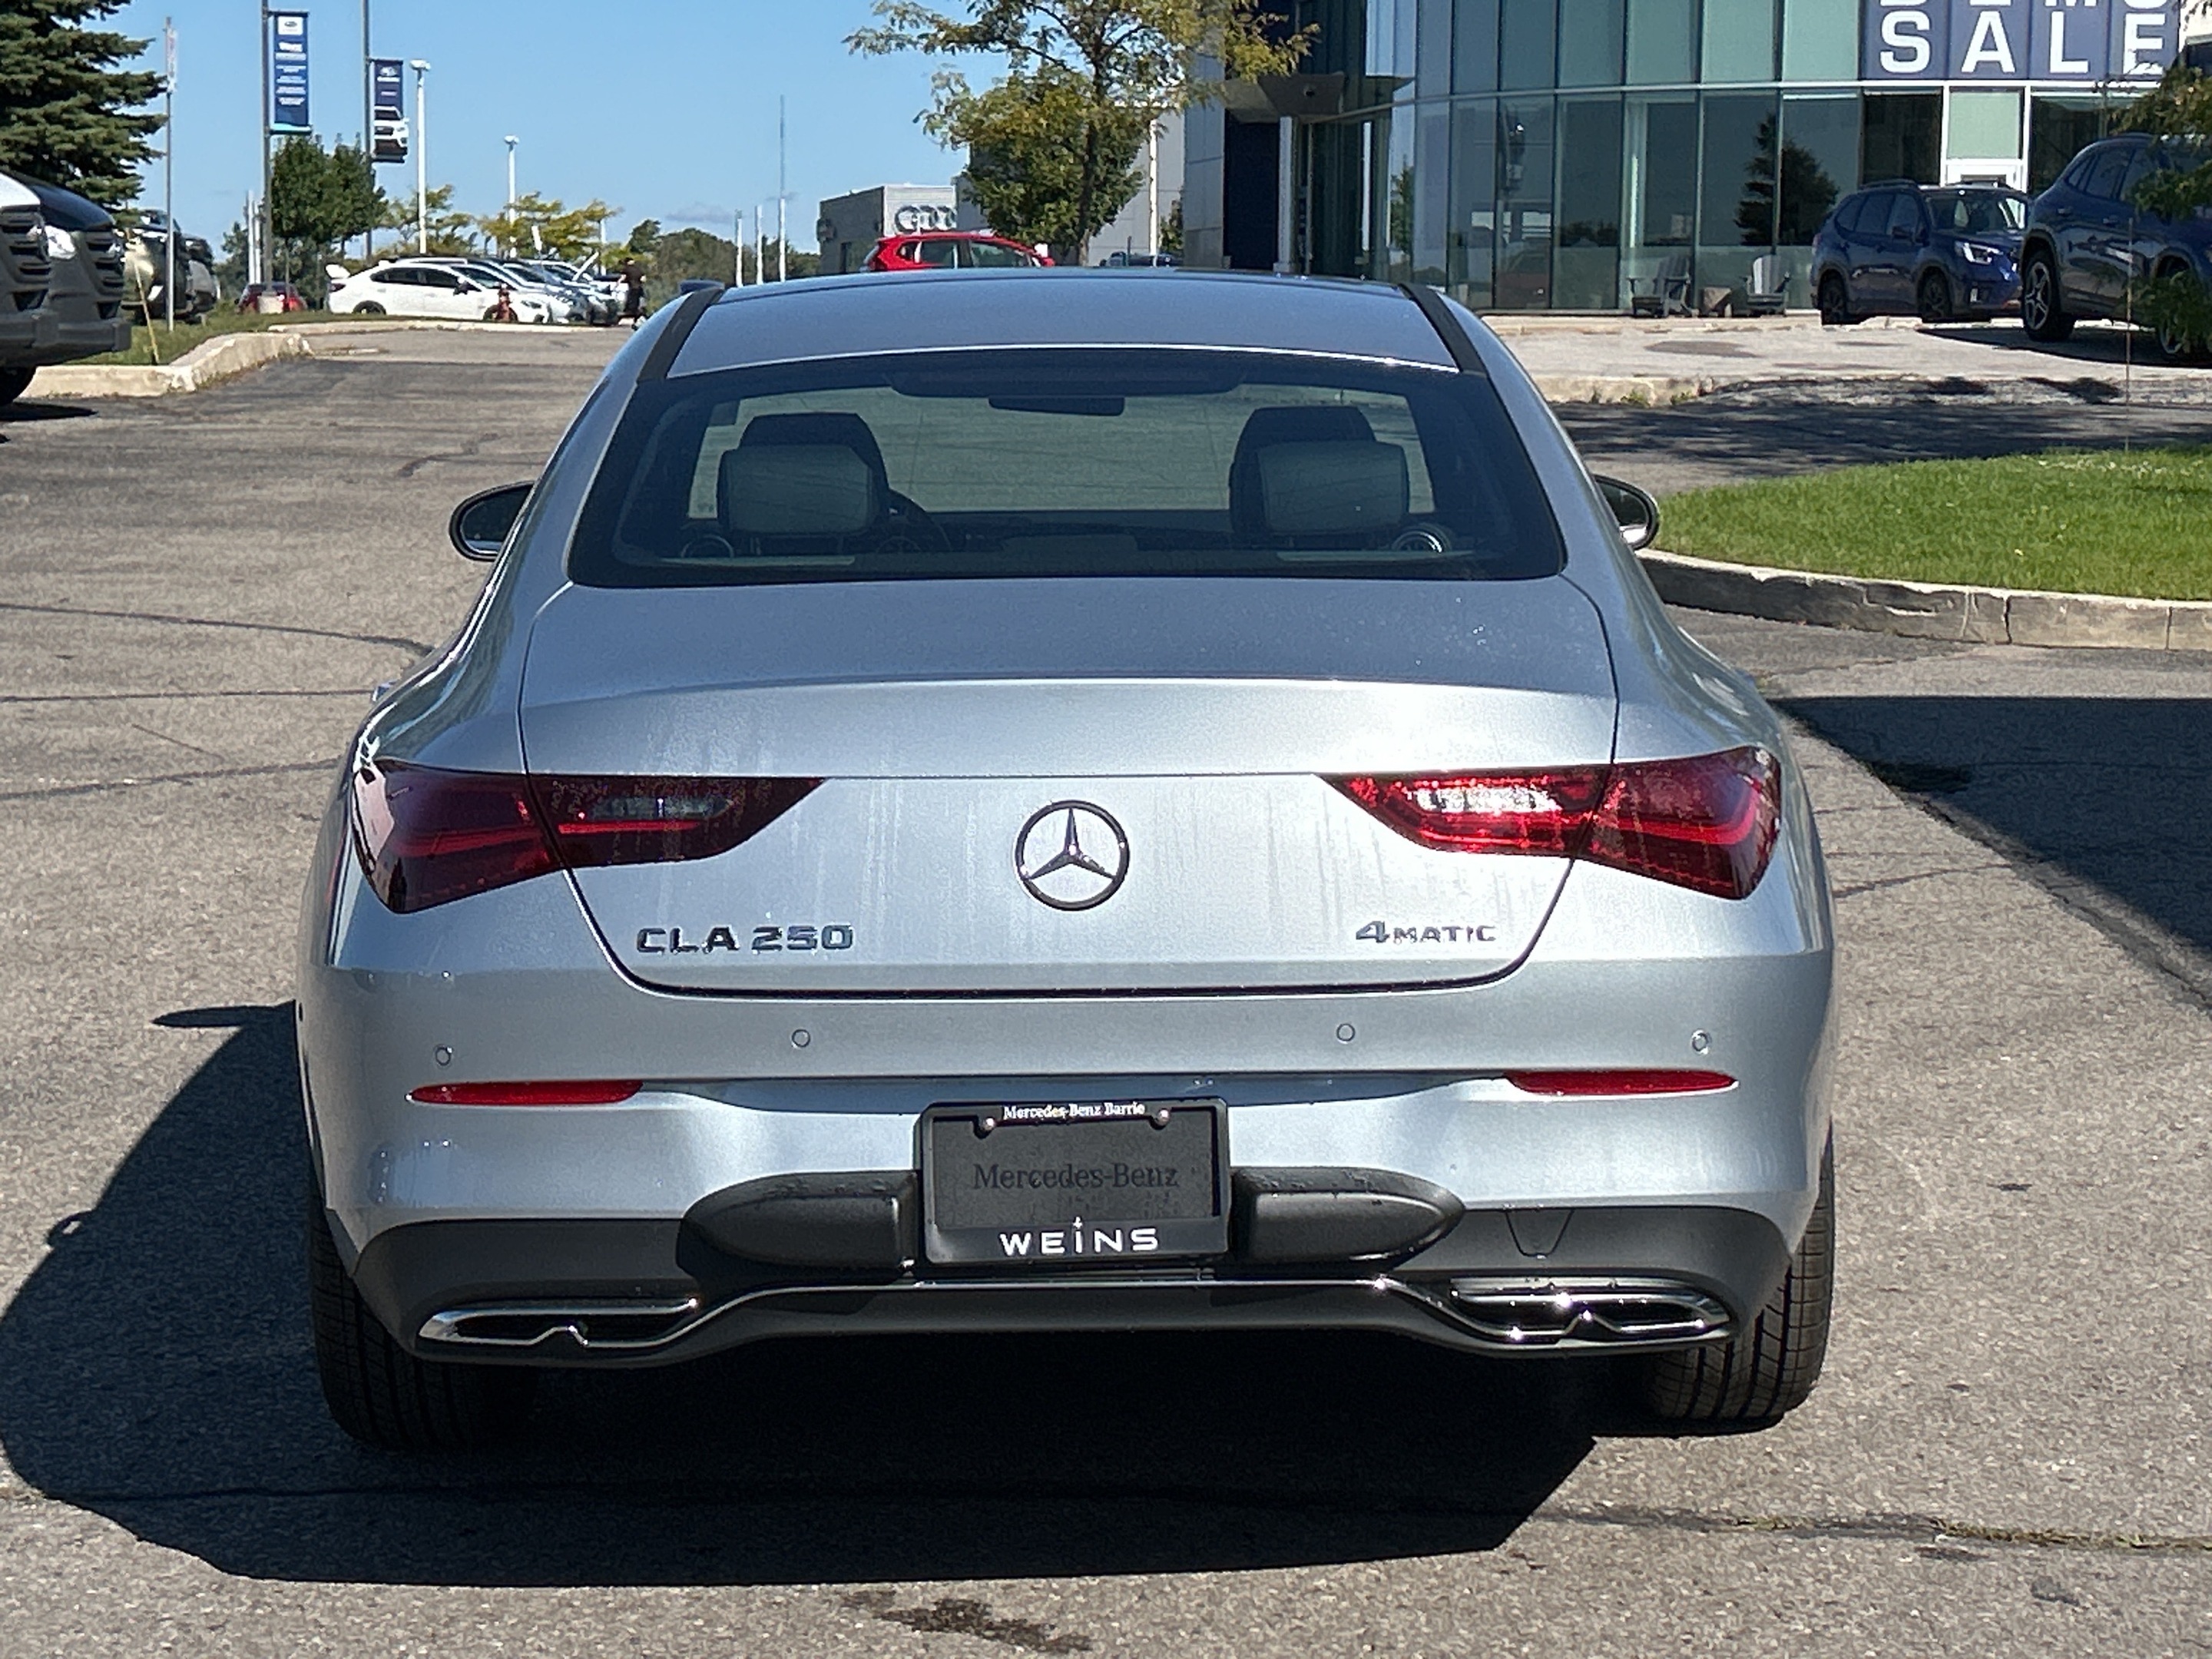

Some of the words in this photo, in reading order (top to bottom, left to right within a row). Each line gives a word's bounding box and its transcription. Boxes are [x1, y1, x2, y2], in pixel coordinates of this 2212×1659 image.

[1879, 10, 2167, 75] SALE
[637, 926, 740, 953] CLA
[752, 924, 854, 952] 250
[1356, 920, 1497, 943] 4MATIC
[1003, 1103, 1101, 1119] Mercedes-Benz
[1104, 1101, 1146, 1115] Barrie
[973, 1162, 1180, 1190] Mercedes-Benz
